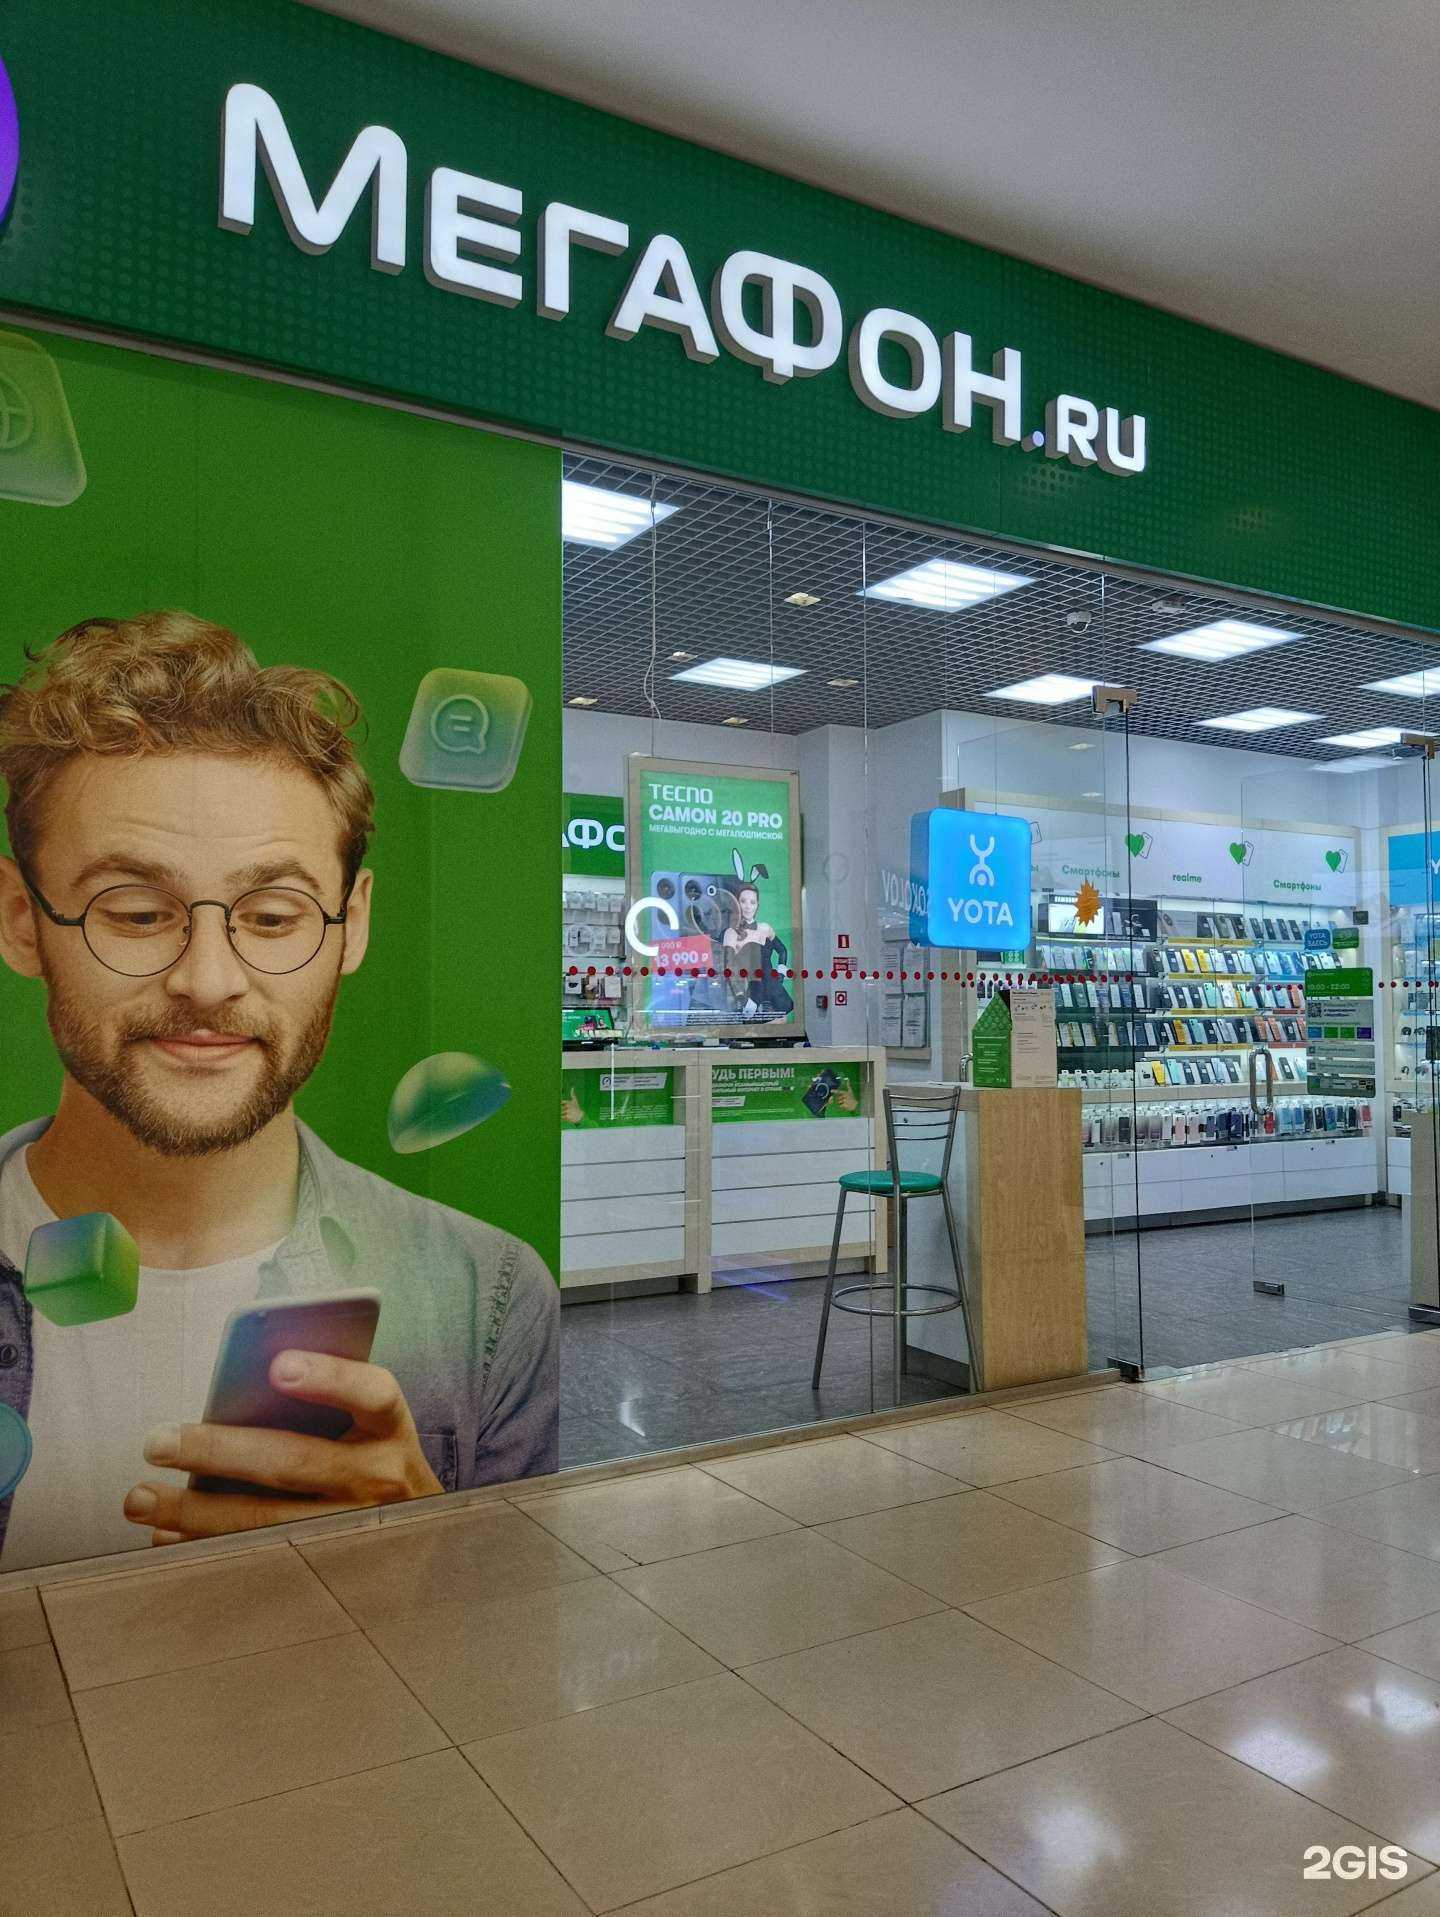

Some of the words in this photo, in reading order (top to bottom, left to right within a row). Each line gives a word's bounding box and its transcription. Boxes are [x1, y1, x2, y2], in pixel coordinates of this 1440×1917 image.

[648, 804, 717, 825] CAMON
[721, 809, 743, 826] 20
[747, 811, 783, 830] PRO
[649, 823, 707, 837] МЕГАВЫГОДНО
[1062, 864, 1121, 879] Смартфоны
[1172, 872, 1202, 884] realme
[1273, 879, 1322, 893] Смартфоны
[947, 897, 1014, 928] YOTA
[672, 950, 699, 965] 990
[739, 1067, 795, 1080] ПЕРВЫМ!
